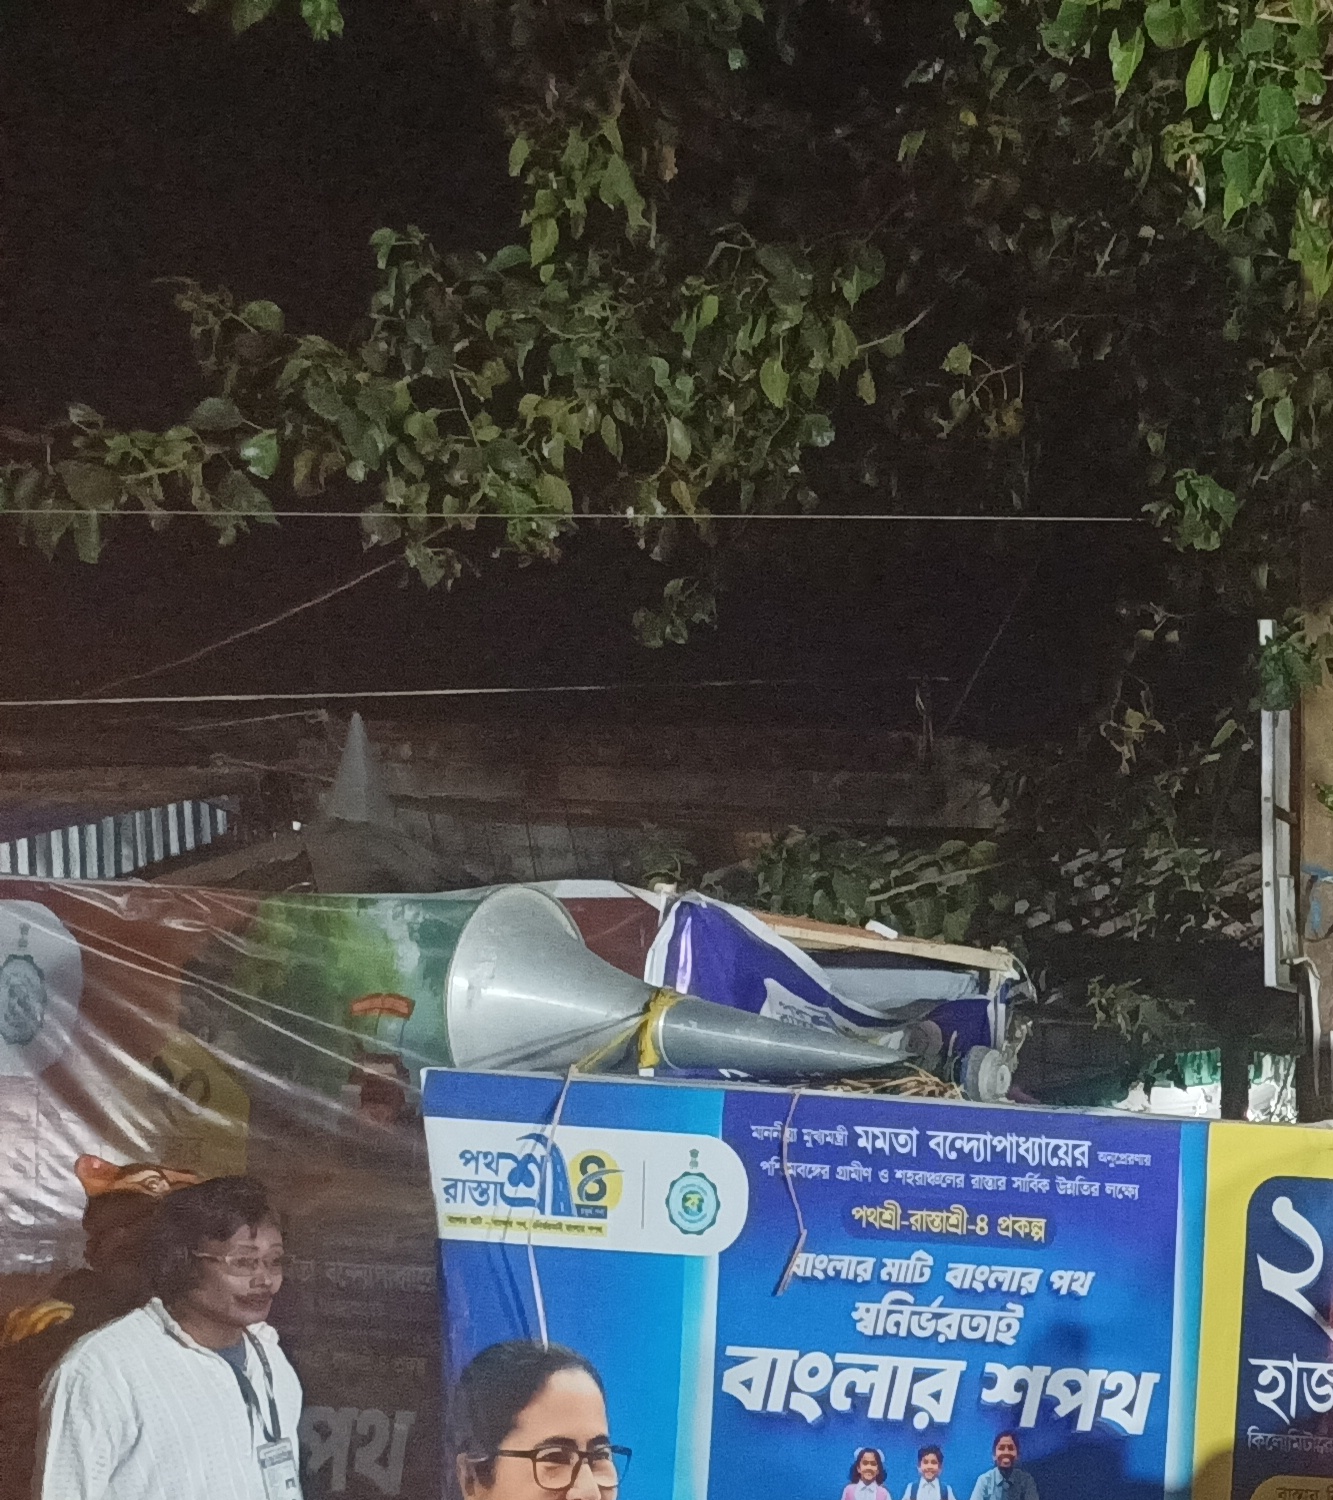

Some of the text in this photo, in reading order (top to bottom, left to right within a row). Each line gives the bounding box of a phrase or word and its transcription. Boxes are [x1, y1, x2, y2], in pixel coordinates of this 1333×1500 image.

[854, 1126, 919, 1158] মমতা
[929, 1129, 1092, 1168] বন্দ্যোপাধ্যায়ের
[791, 1250, 1096, 1297] বাংলার মাটি বাংলার পথ
[851, 1290, 1025, 1346] স্বনির্ভরতাই
[721, 1345, 1161, 1436] বাংলার শপথ
